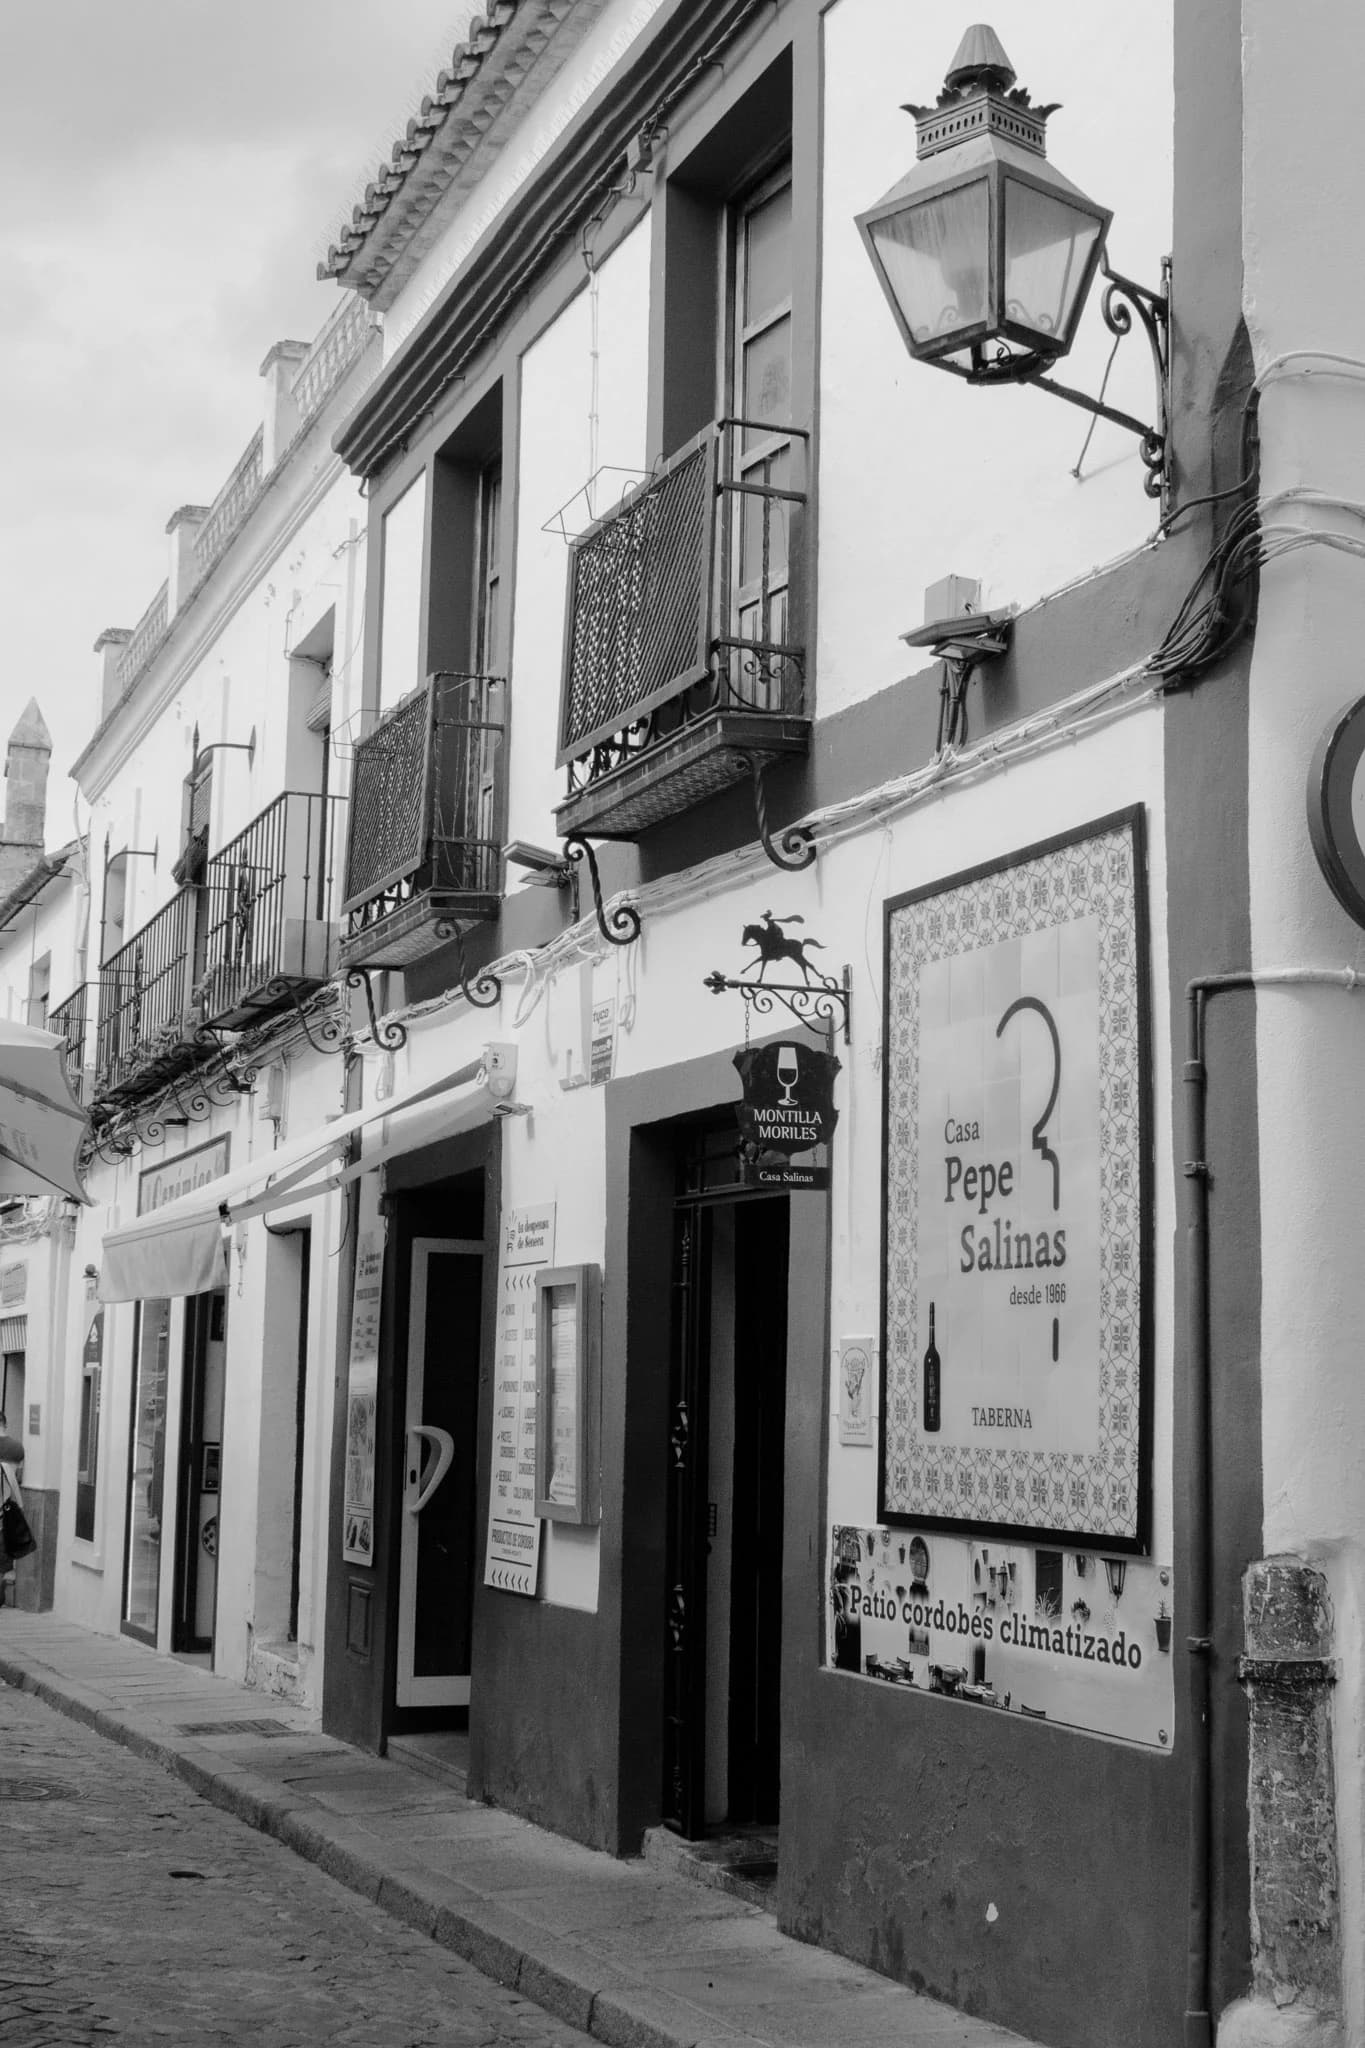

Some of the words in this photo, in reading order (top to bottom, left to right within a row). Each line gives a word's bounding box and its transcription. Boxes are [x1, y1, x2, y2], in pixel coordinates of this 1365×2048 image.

[593, 1008, 609, 1024] tyco
[754, 1109, 822, 1124] MONTILLA
[759, 1125, 817, 1140] MORILES
[944, 1118, 980, 1144] Casa
[759, 1171, 781, 1182] Casa
[783, 1171, 814, 1183] Salinas
[944, 1156, 1014, 1214] Pepe
[960, 1218, 1067, 1273] Salinas
[1009, 1286, 1042, 1305] desde
[1045, 1283, 1066, 1304] 1966
[972, 1407, 1033, 1429] TABERNA
[850, 1585, 897, 1622] Patio
[902, 1599, 993, 1640] cordobés
[1000, 1612, 1142, 1669] climatizado
